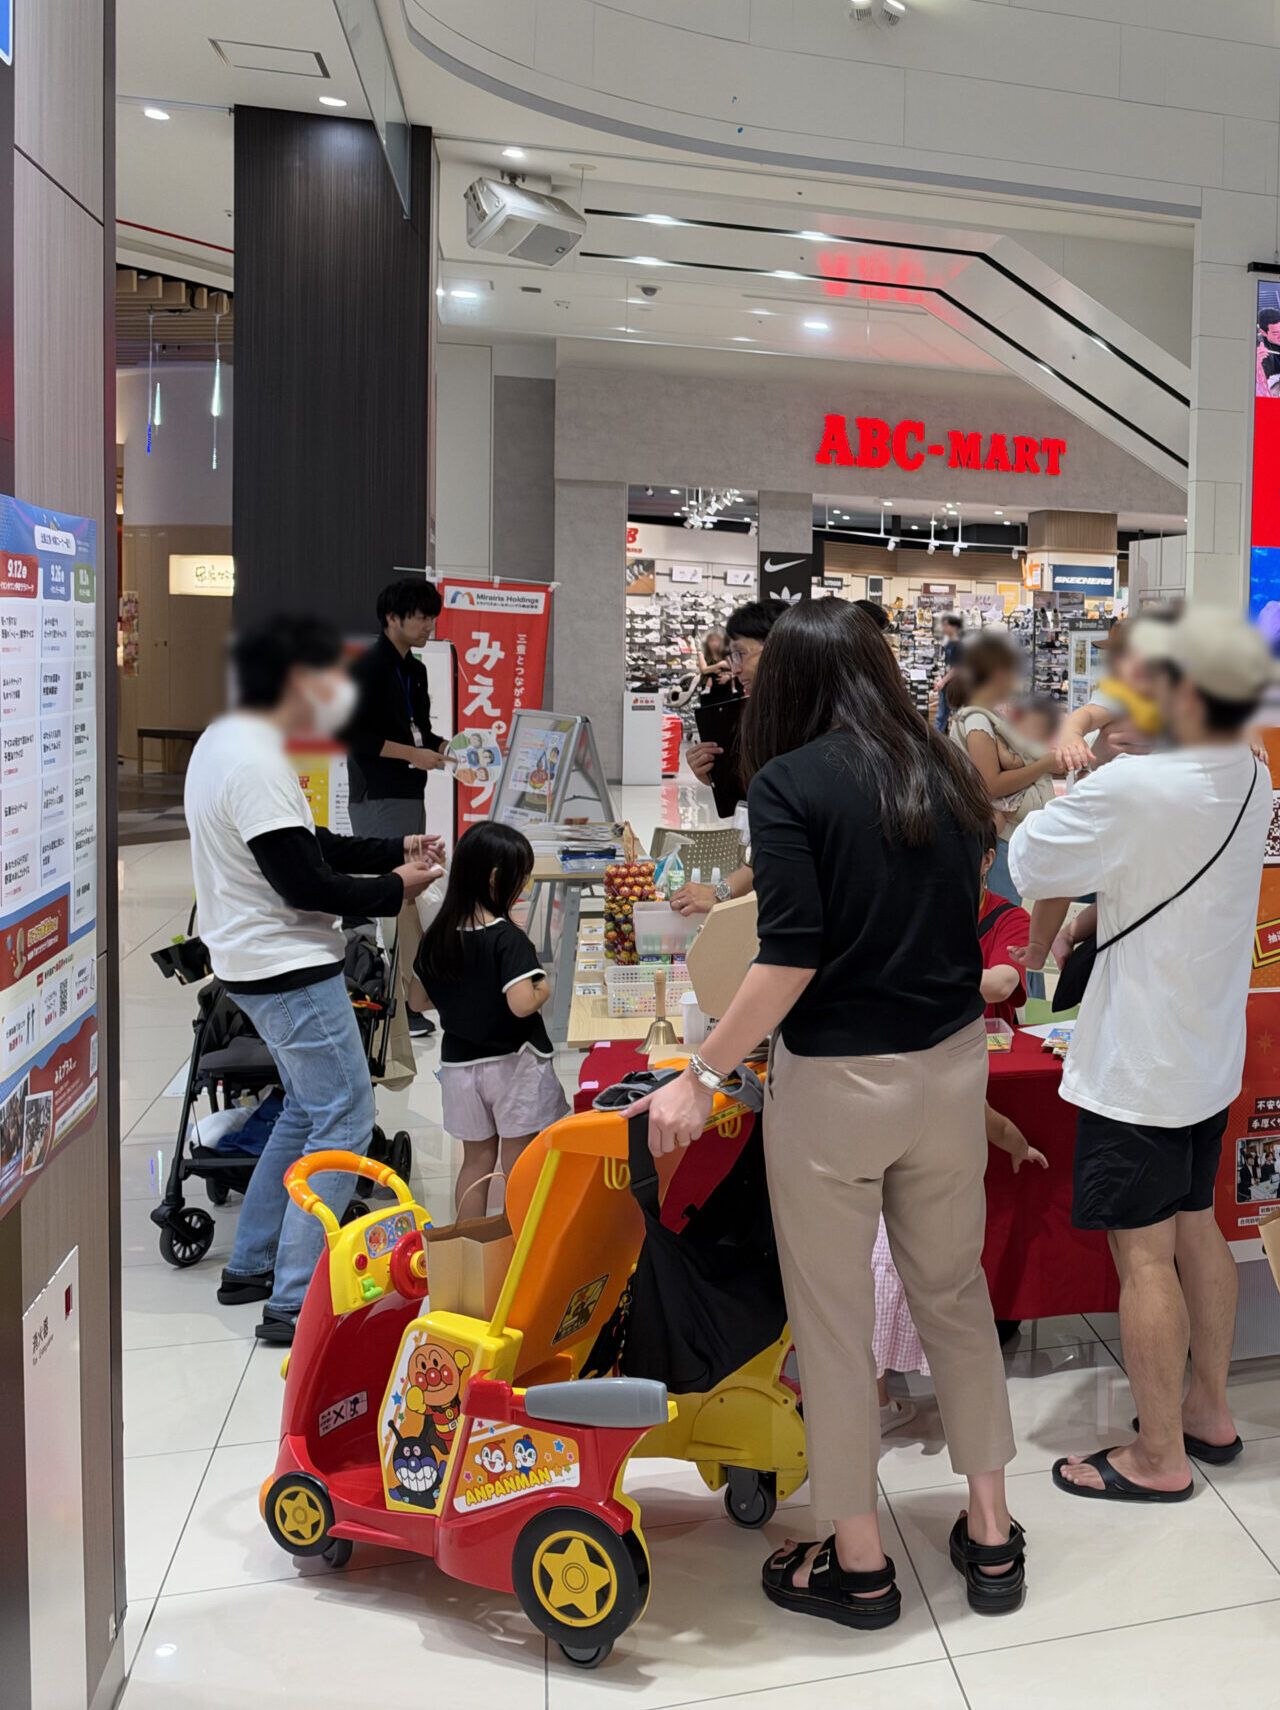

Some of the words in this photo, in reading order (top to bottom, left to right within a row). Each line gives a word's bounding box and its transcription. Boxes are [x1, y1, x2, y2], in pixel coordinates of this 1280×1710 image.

[815, 414, 1067, 477] ABC-MART
[1054, 576, 1113, 586] SKECHERS
[506, 595, 539, 604] Holdings
[465, 1466, 553, 1507] ANPANMAN
